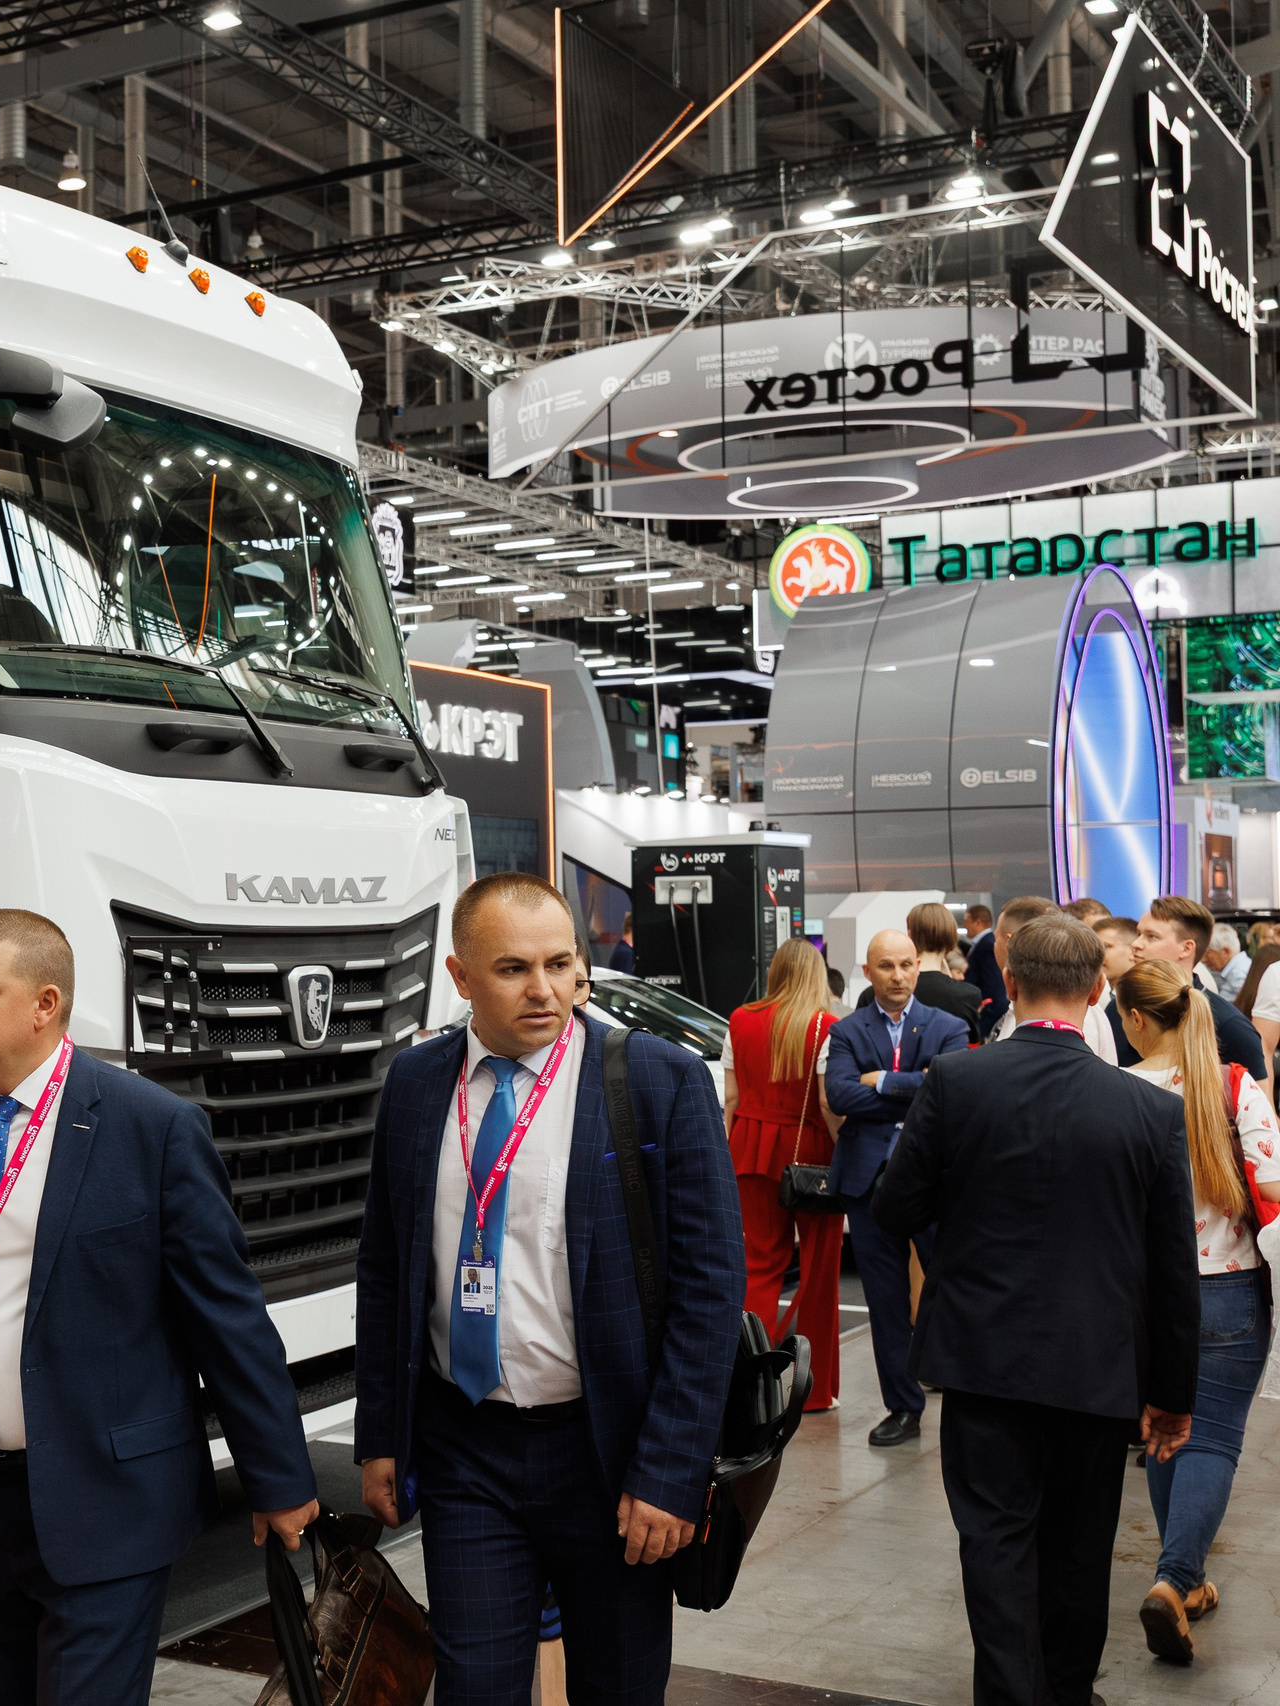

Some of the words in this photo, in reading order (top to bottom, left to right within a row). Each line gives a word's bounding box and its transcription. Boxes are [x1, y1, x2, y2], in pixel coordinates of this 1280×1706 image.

[1010, 333, 1069, 352] НТЕР
[888, 517, 1258, 586] Татарстан
[439, 703, 524, 762] КРЭТ
[981, 768, 1038, 784] ELSIB
[694, 852, 726, 864] КРЭТ
[783, 868, 800, 882] КРЭТ
[224, 872, 388, 904] KAMAZ
[539, 1048, 560, 1084] ИННОПРОМ
[38, 1084, 59, 1121] ИННОПРОМ
[519, 1091, 539, 1125] INNOPROM
[19, 1129, 38, 1163] INNOPROM
[496, 1131, 518, 1169] ИННОПРОМ
